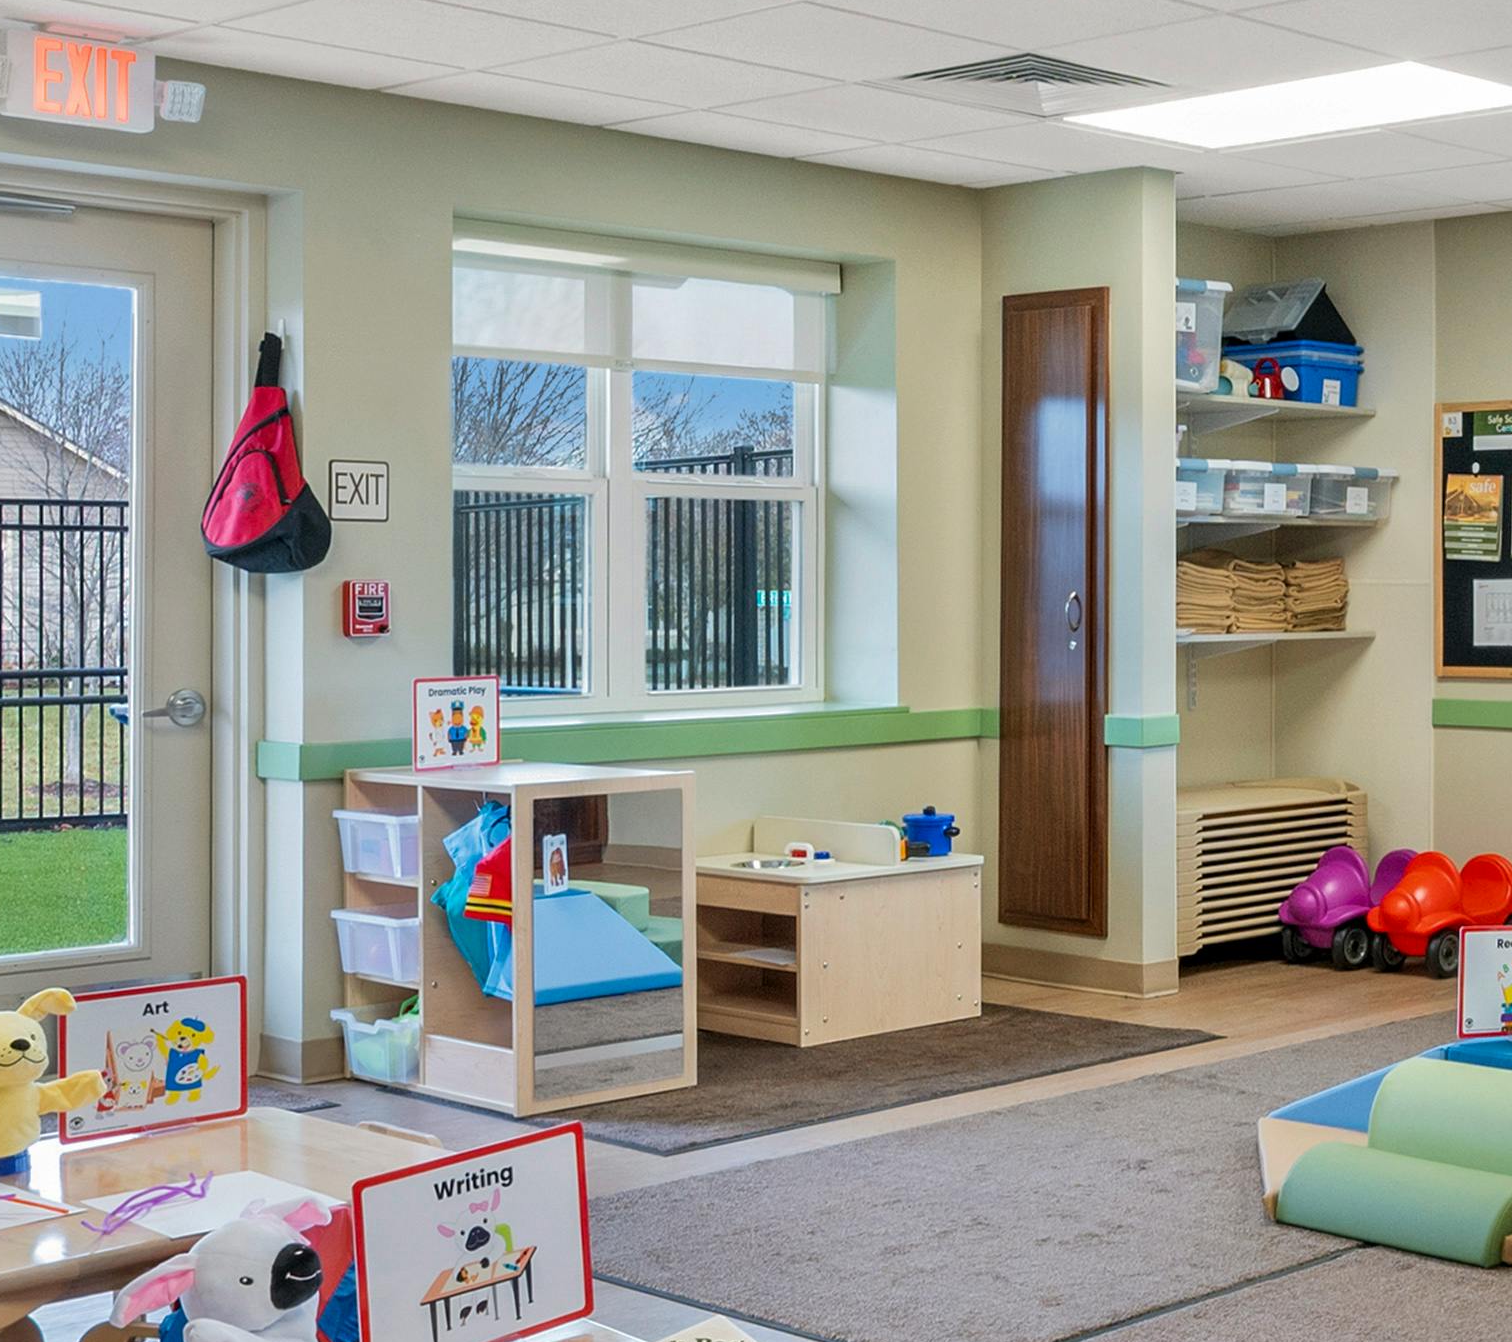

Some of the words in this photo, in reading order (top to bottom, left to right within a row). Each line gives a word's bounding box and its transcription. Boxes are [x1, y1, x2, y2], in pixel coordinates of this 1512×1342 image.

[33, 36, 136, 123] EXIT
[1487, 414, 1503, 425] Safe
[335, 472, 385, 505] EXIT
[1469, 478, 1497, 494] safe
[355, 583, 385, 595] FIRE
[428, 686, 467, 697] Dramatic
[468, 686, 487, 696] Play
[142, 1001, 170, 1017] Art
[433, 1166, 514, 1201] Writing
